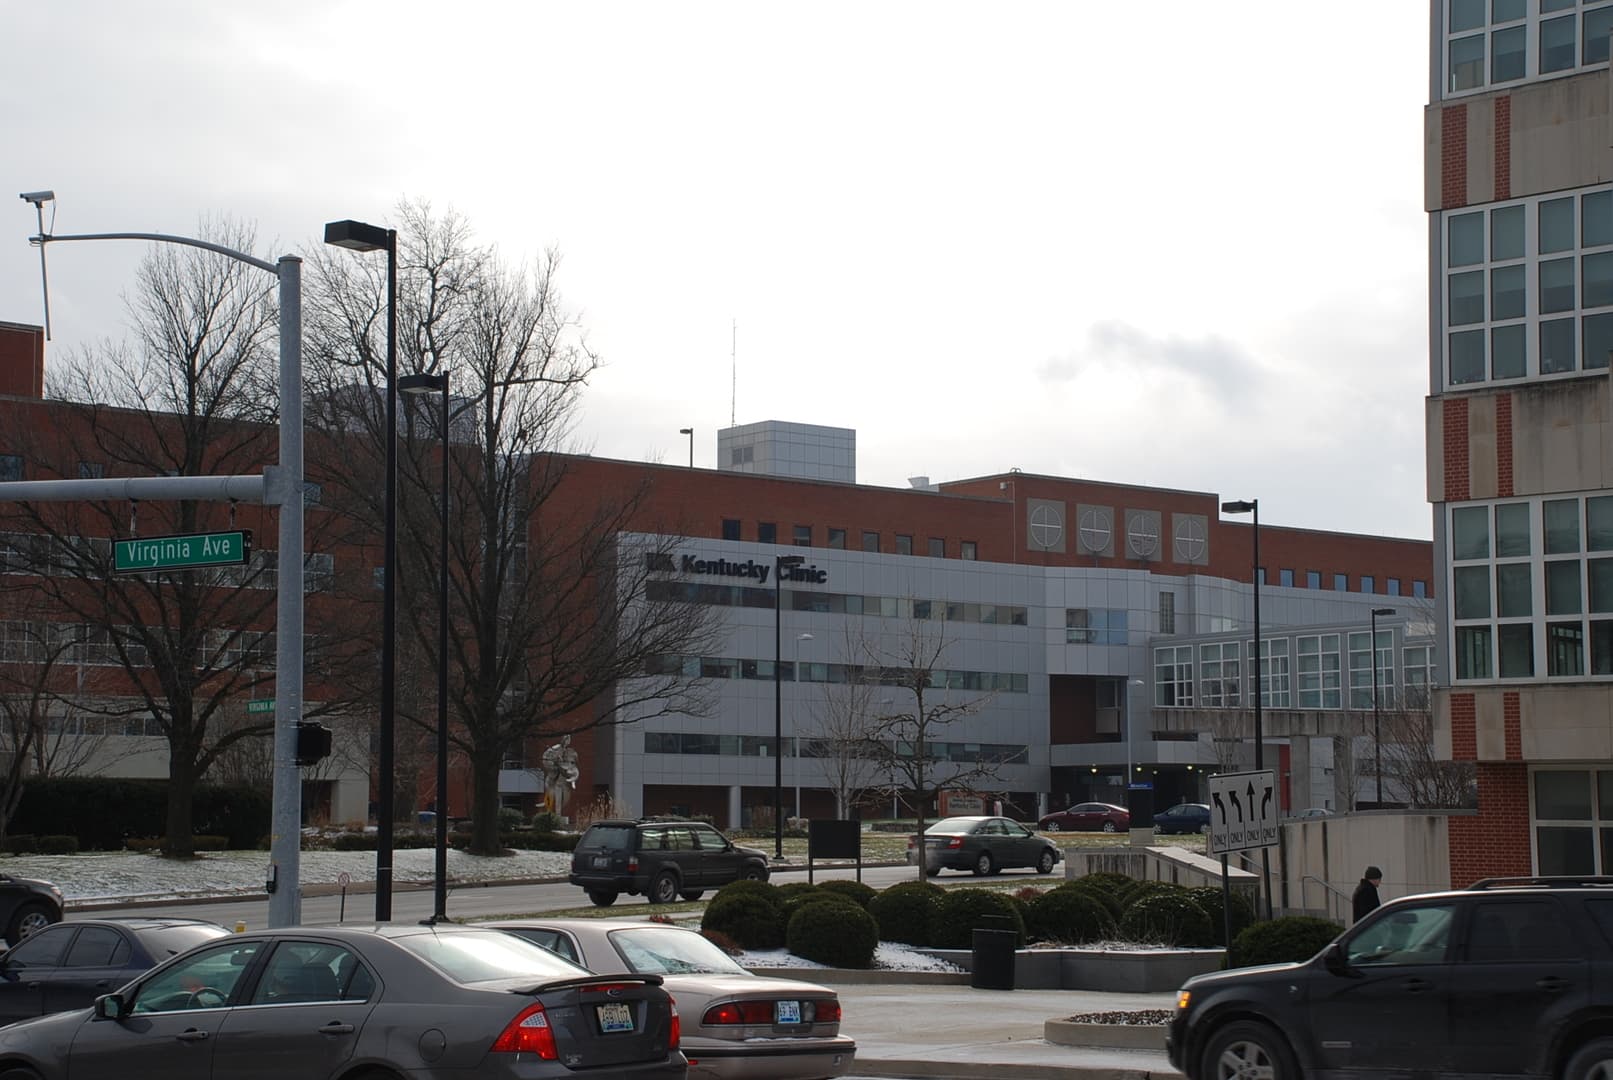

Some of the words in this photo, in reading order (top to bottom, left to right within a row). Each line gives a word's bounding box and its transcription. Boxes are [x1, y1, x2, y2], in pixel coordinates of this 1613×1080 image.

[127, 540, 190, 567] Virginia
[202, 536, 230, 556] Ave
[681, 554, 770, 584] Kentucky
[775, 561, 827, 584] Clinic
[1214, 834, 1227, 847] ONLY
[1230, 831, 1243, 844] ONLY
[1247, 829, 1260, 842] ONLY
[1263, 827, 1276, 842] ONLY
